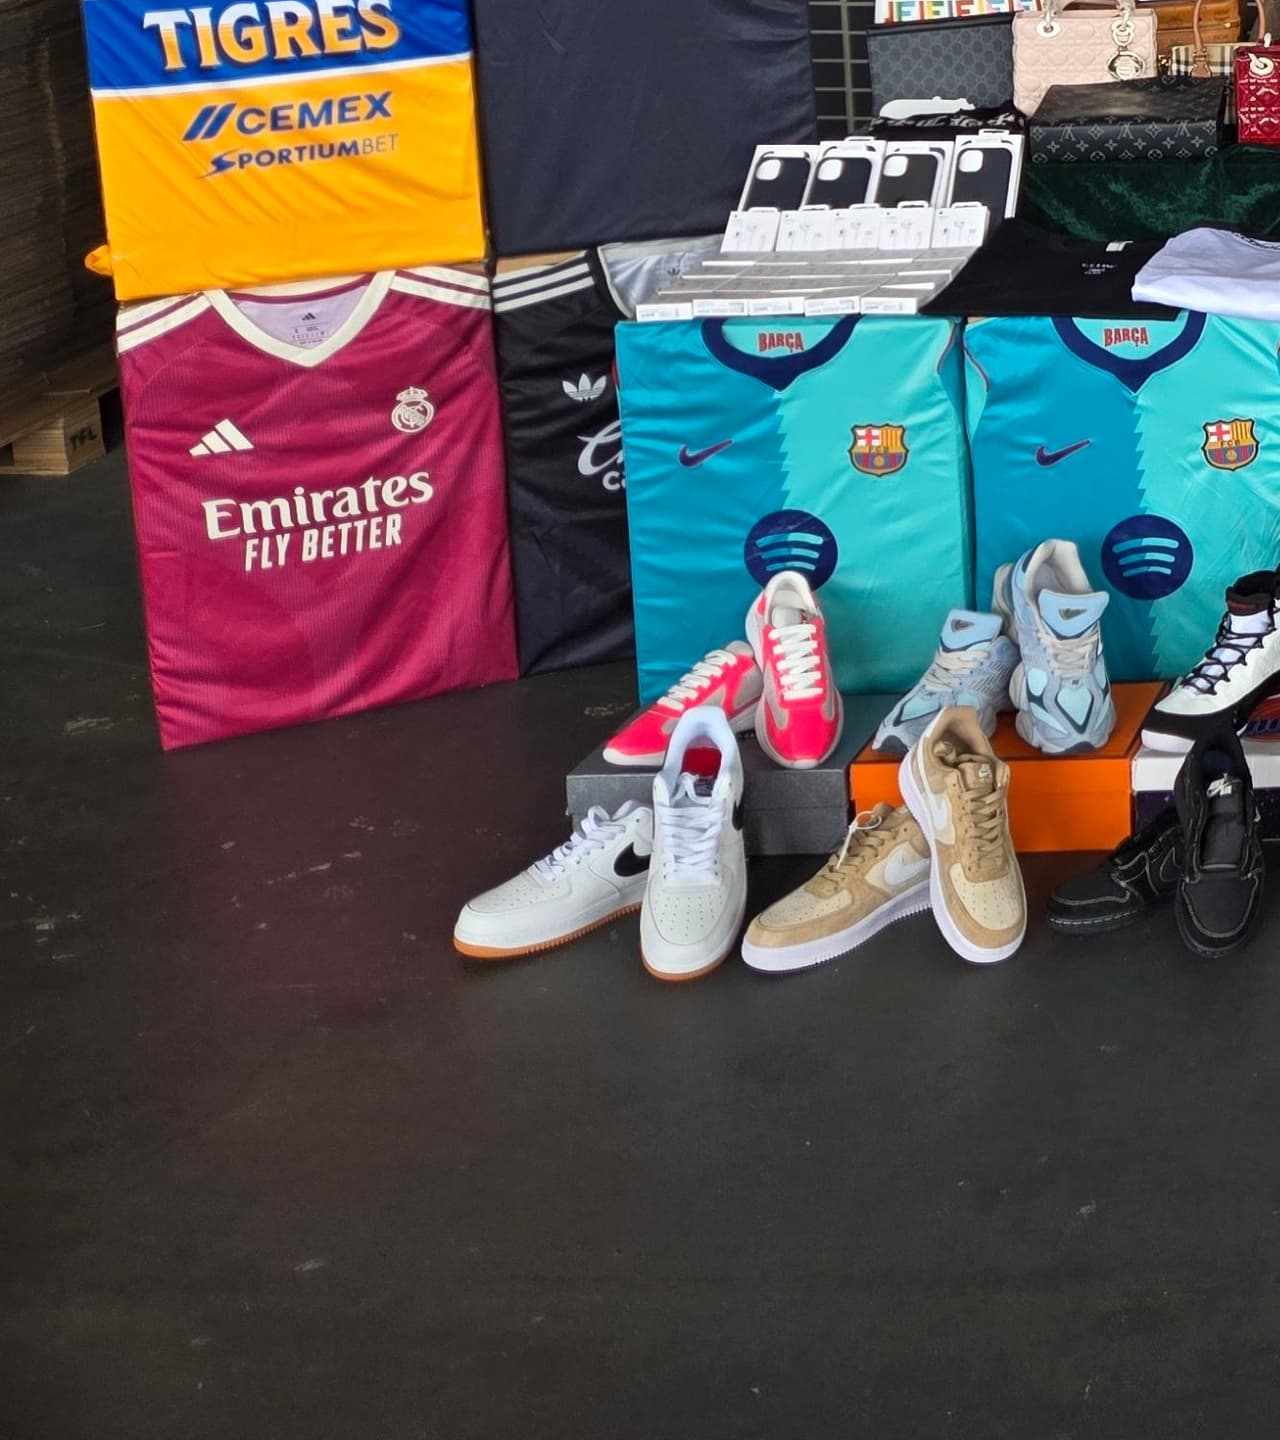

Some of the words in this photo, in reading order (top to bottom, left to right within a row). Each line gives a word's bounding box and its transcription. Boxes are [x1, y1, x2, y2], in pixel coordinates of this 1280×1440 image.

[236, 91, 393, 135] CEMEX
[757, 331, 804, 354] BARÇA
[1103, 326, 1149, 349] BARÇA
[202, 470, 434, 540] Emirates
[245, 533, 290, 572] FLY
[301, 513, 403, 564] BETTER
